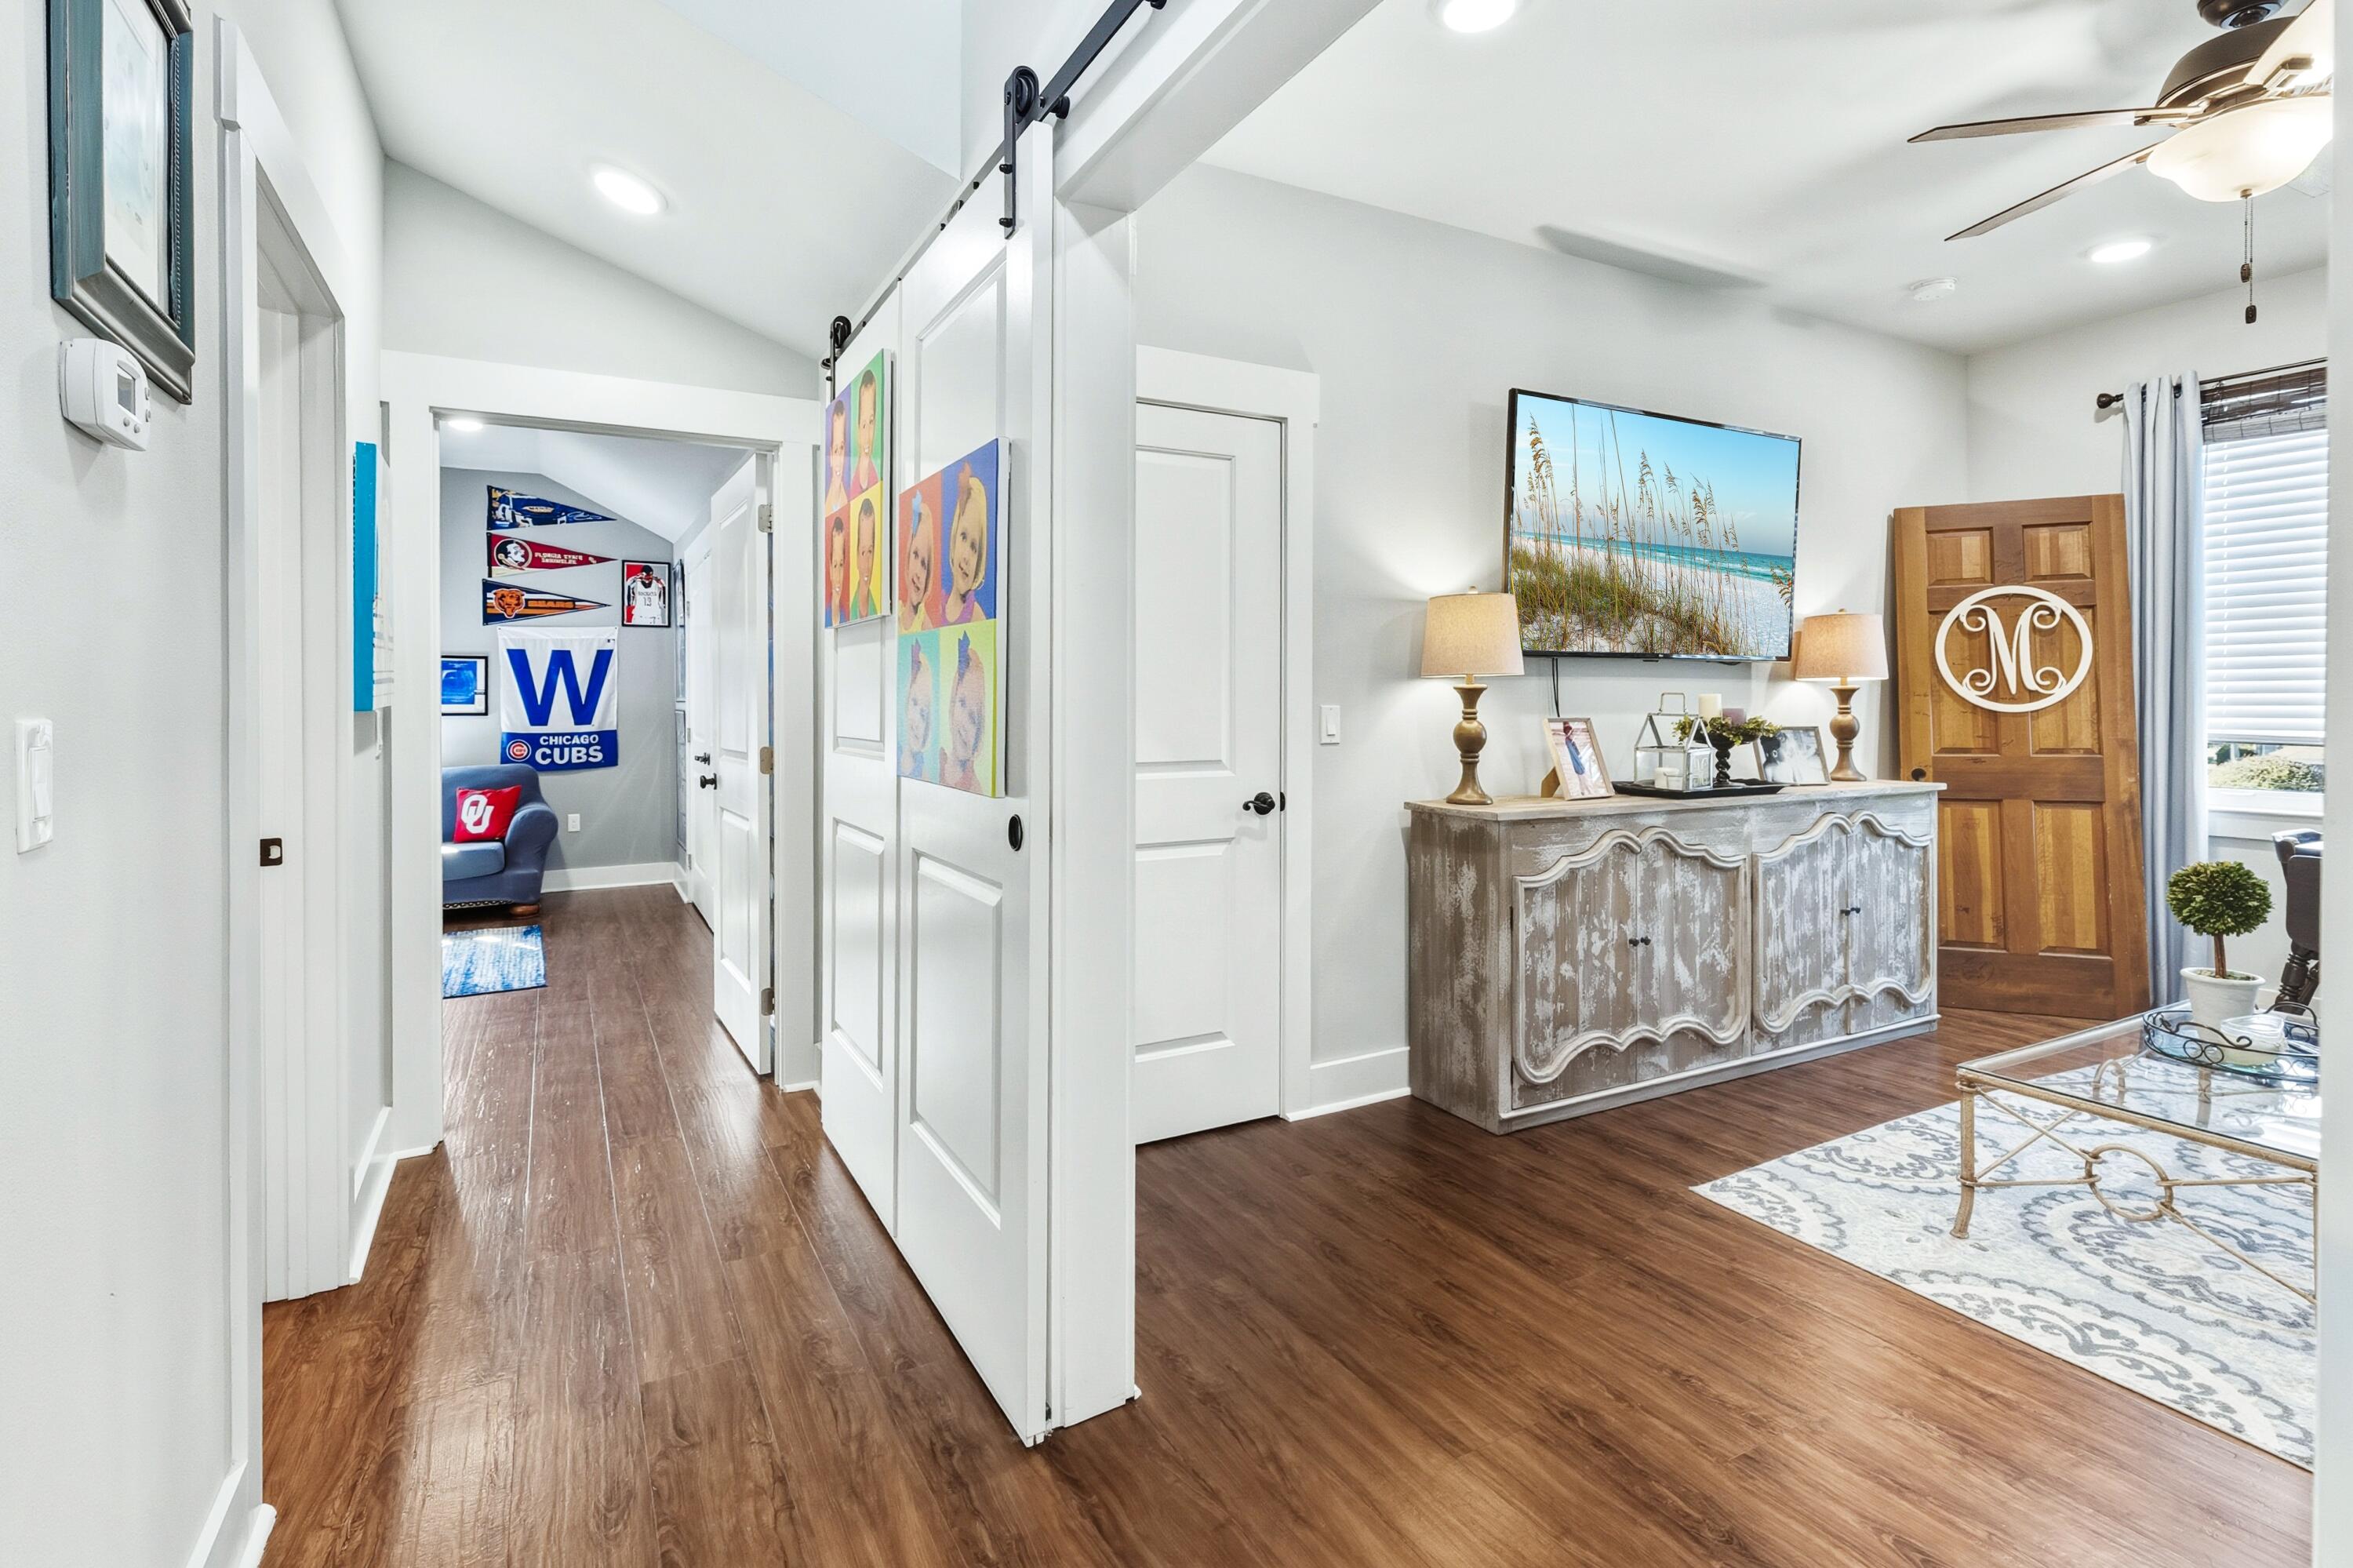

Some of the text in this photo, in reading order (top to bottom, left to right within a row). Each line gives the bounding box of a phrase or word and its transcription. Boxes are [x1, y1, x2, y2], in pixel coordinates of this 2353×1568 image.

[1959, 601, 2067, 696] M
[506, 649, 613, 726] W
[535, 745, 603, 765] CUBS
[540, 734, 599, 745] CHICAGO
[461, 794, 495, 834] OU
